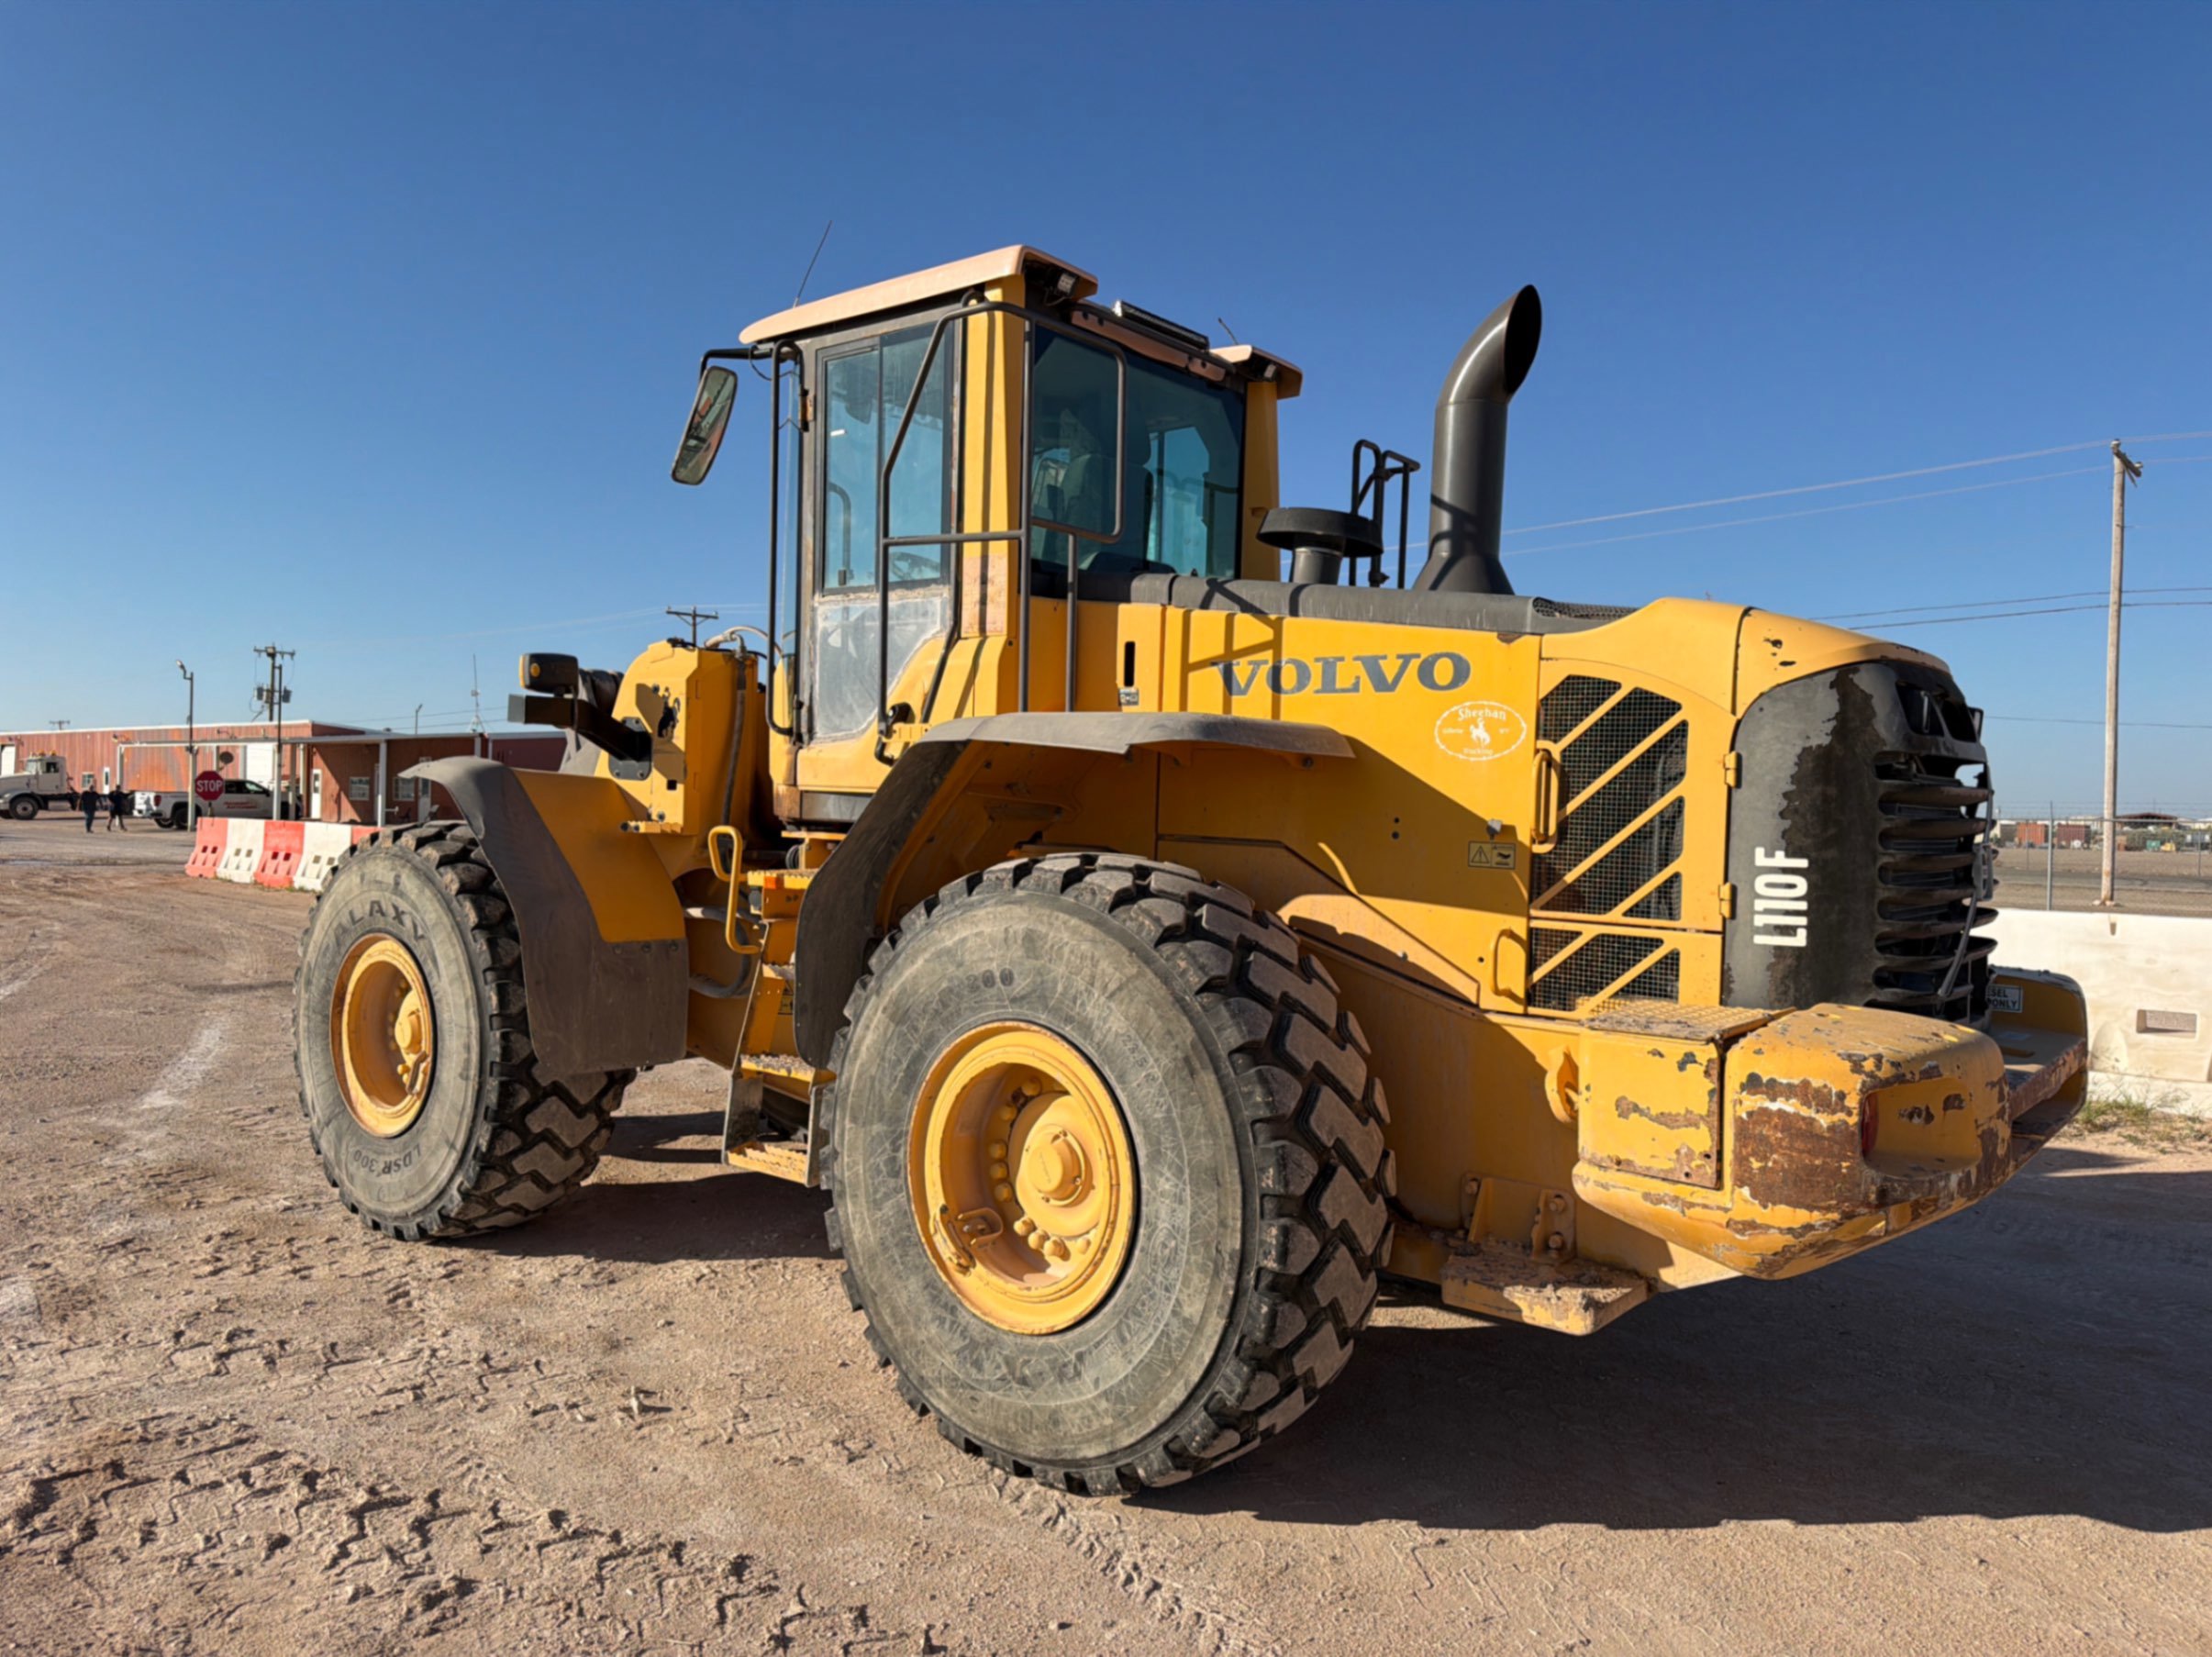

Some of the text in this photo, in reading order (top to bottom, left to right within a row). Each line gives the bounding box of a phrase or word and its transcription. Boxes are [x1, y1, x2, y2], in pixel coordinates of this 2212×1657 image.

[1211, 651, 1472, 696] VOLVO
[1458, 706, 1506, 722] Sheehan
[196, 780, 223, 792] STOP
[1753, 847, 1808, 947] L110F
[1992, 998, 2017, 1008] ONLY
[353, 1143, 422, 1175] LDSR 300
